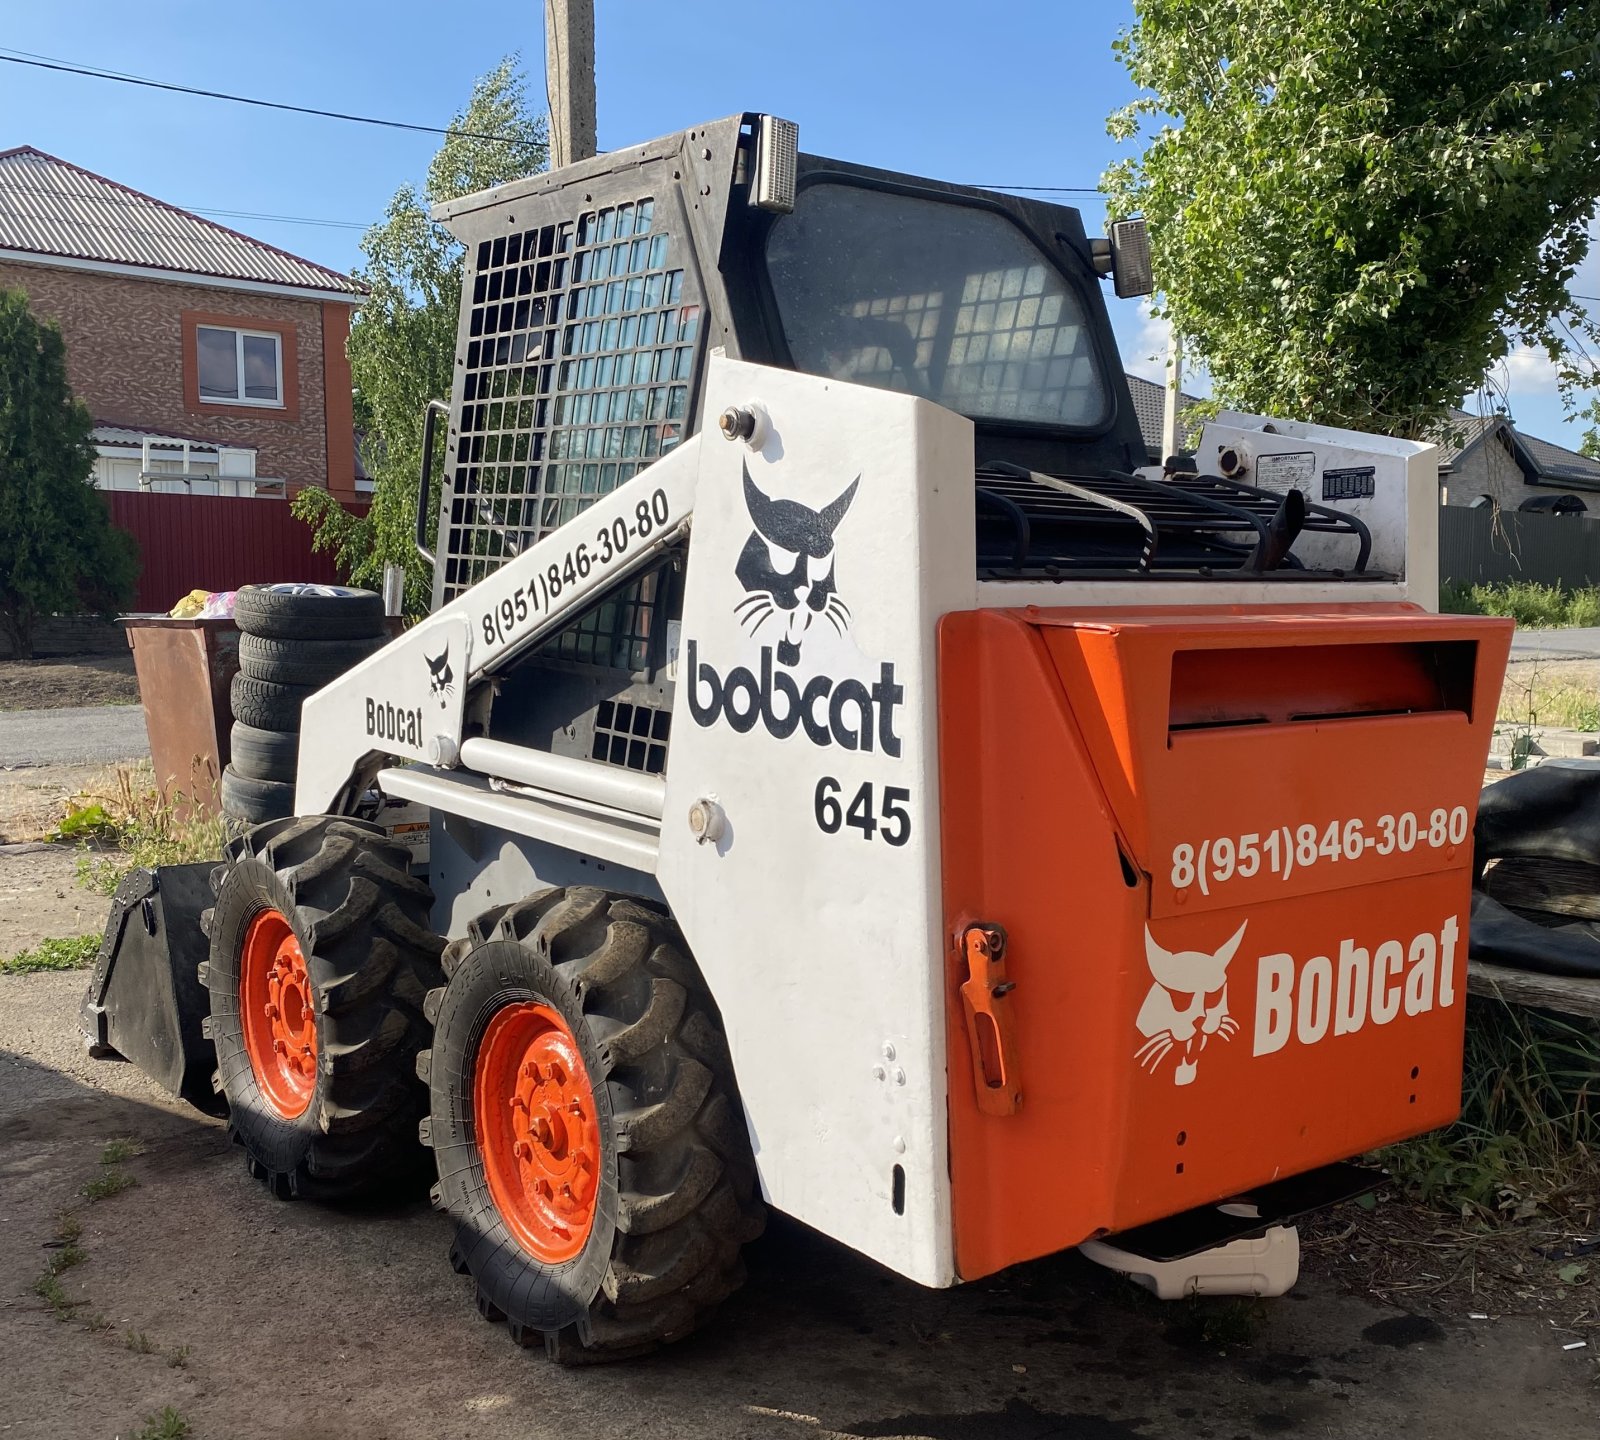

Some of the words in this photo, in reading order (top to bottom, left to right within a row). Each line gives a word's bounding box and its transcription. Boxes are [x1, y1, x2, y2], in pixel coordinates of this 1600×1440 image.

[1271, 455, 1300, 463] IMPORTANT
[482, 488, 670, 646] 8(951)846-30-80
[366, 697, 423, 749] Bobcat
[687, 639, 904, 759] bobcat
[814, 776, 911, 847] 645
[1170, 805, 1469, 896] 8(951)846-30-80
[1252, 914, 1459, 1058] Bobcat
